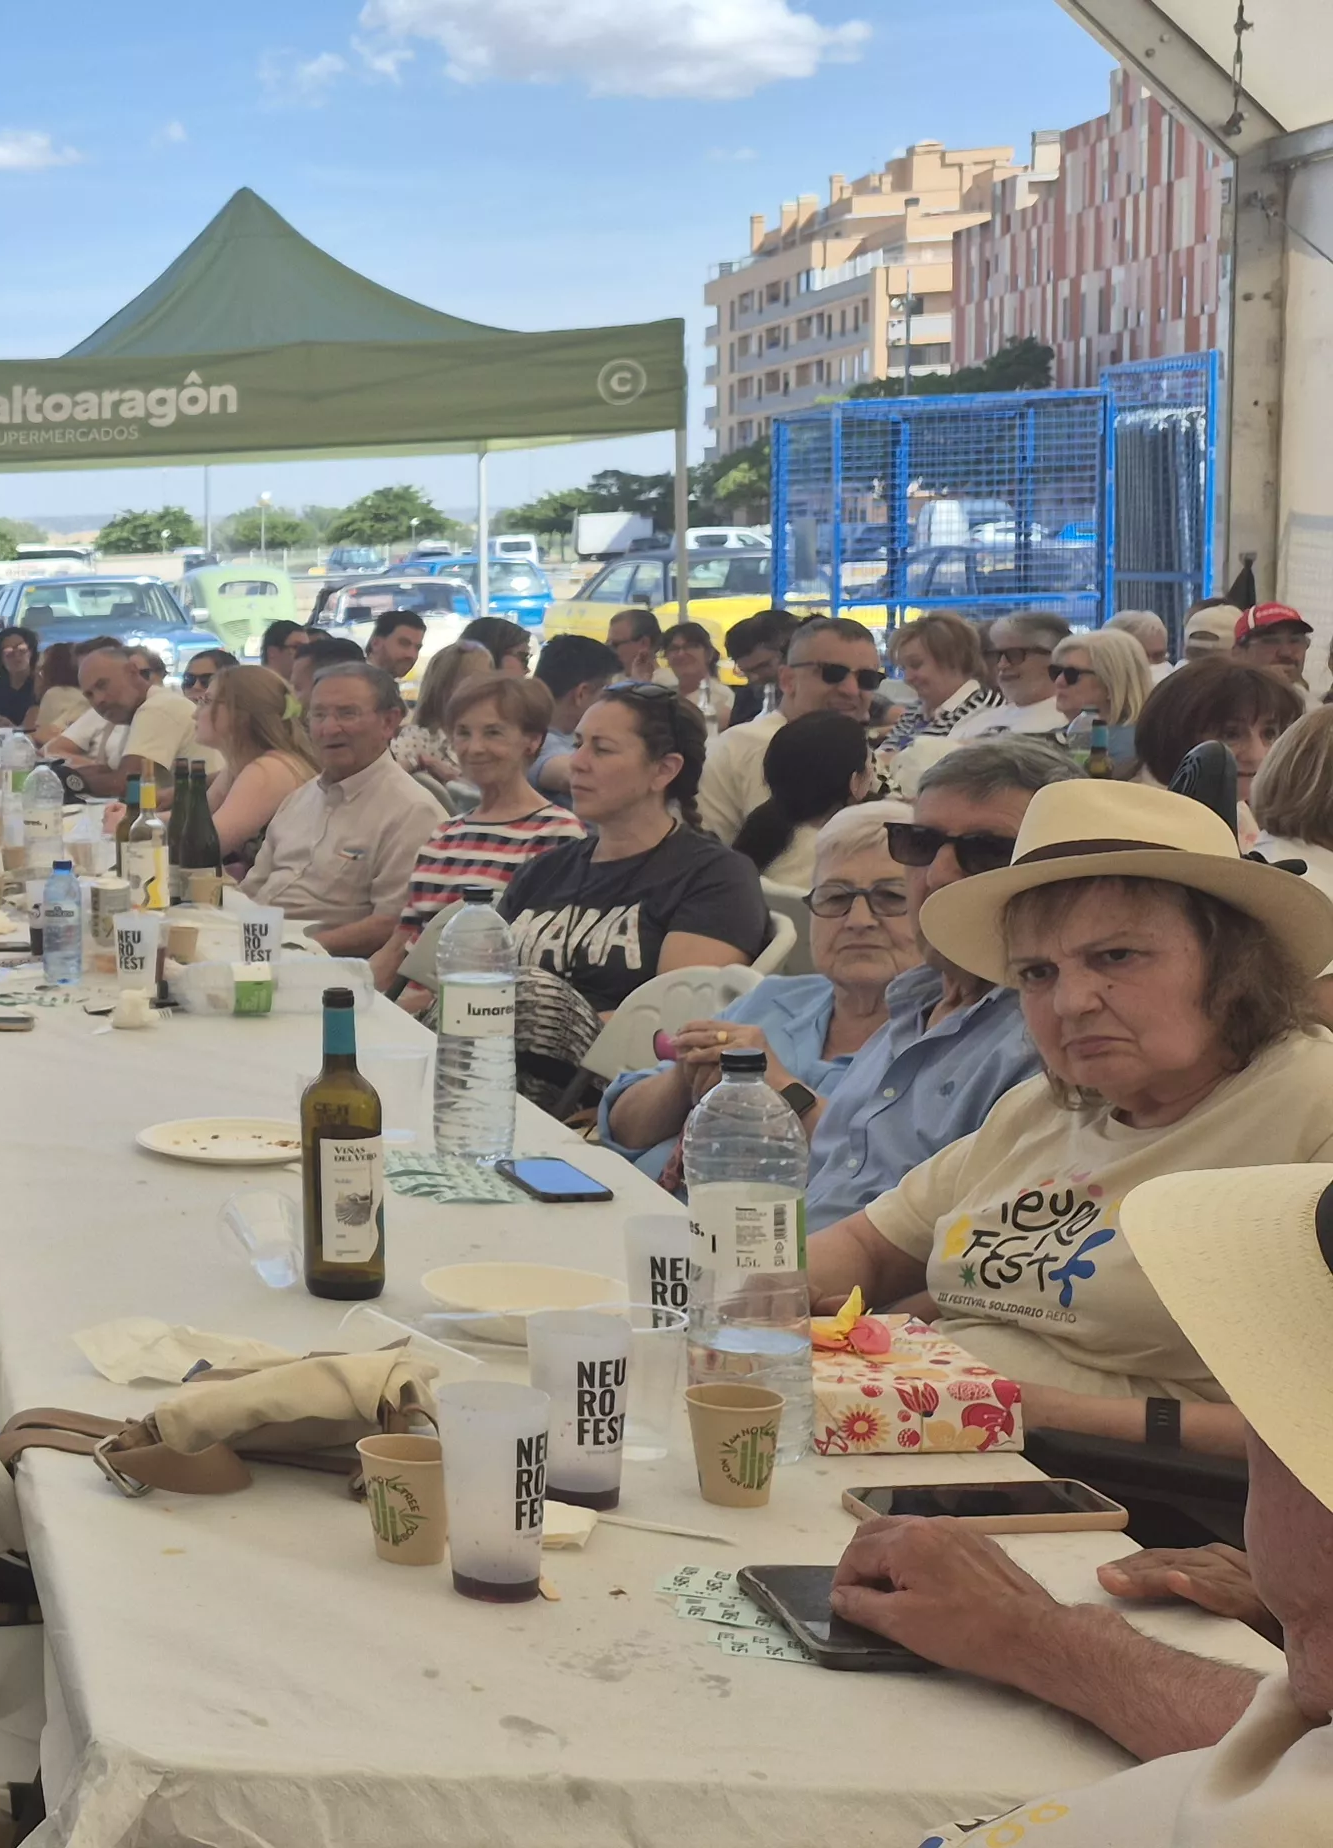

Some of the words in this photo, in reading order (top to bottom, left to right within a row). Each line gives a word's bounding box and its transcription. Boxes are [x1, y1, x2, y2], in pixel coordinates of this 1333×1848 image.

[117, 930, 141, 944] NEU
[243, 922, 269, 937] NEU
[118, 943, 134, 957] RO
[244, 936, 262, 949] RO
[118, 956, 145, 970] FEST
[334, 1154, 354, 1162] DEL
[651, 1281, 689, 1308] RO
[947, 1292, 987, 1309] FESTIVAL
[988, 1298, 1044, 1319] SOLIDARIO
[576, 1356, 627, 1389] NEU
[576, 1389, 616, 1417] RO
[515, 1464, 546, 1500] RO
[399, 1486, 421, 1513] TREE
